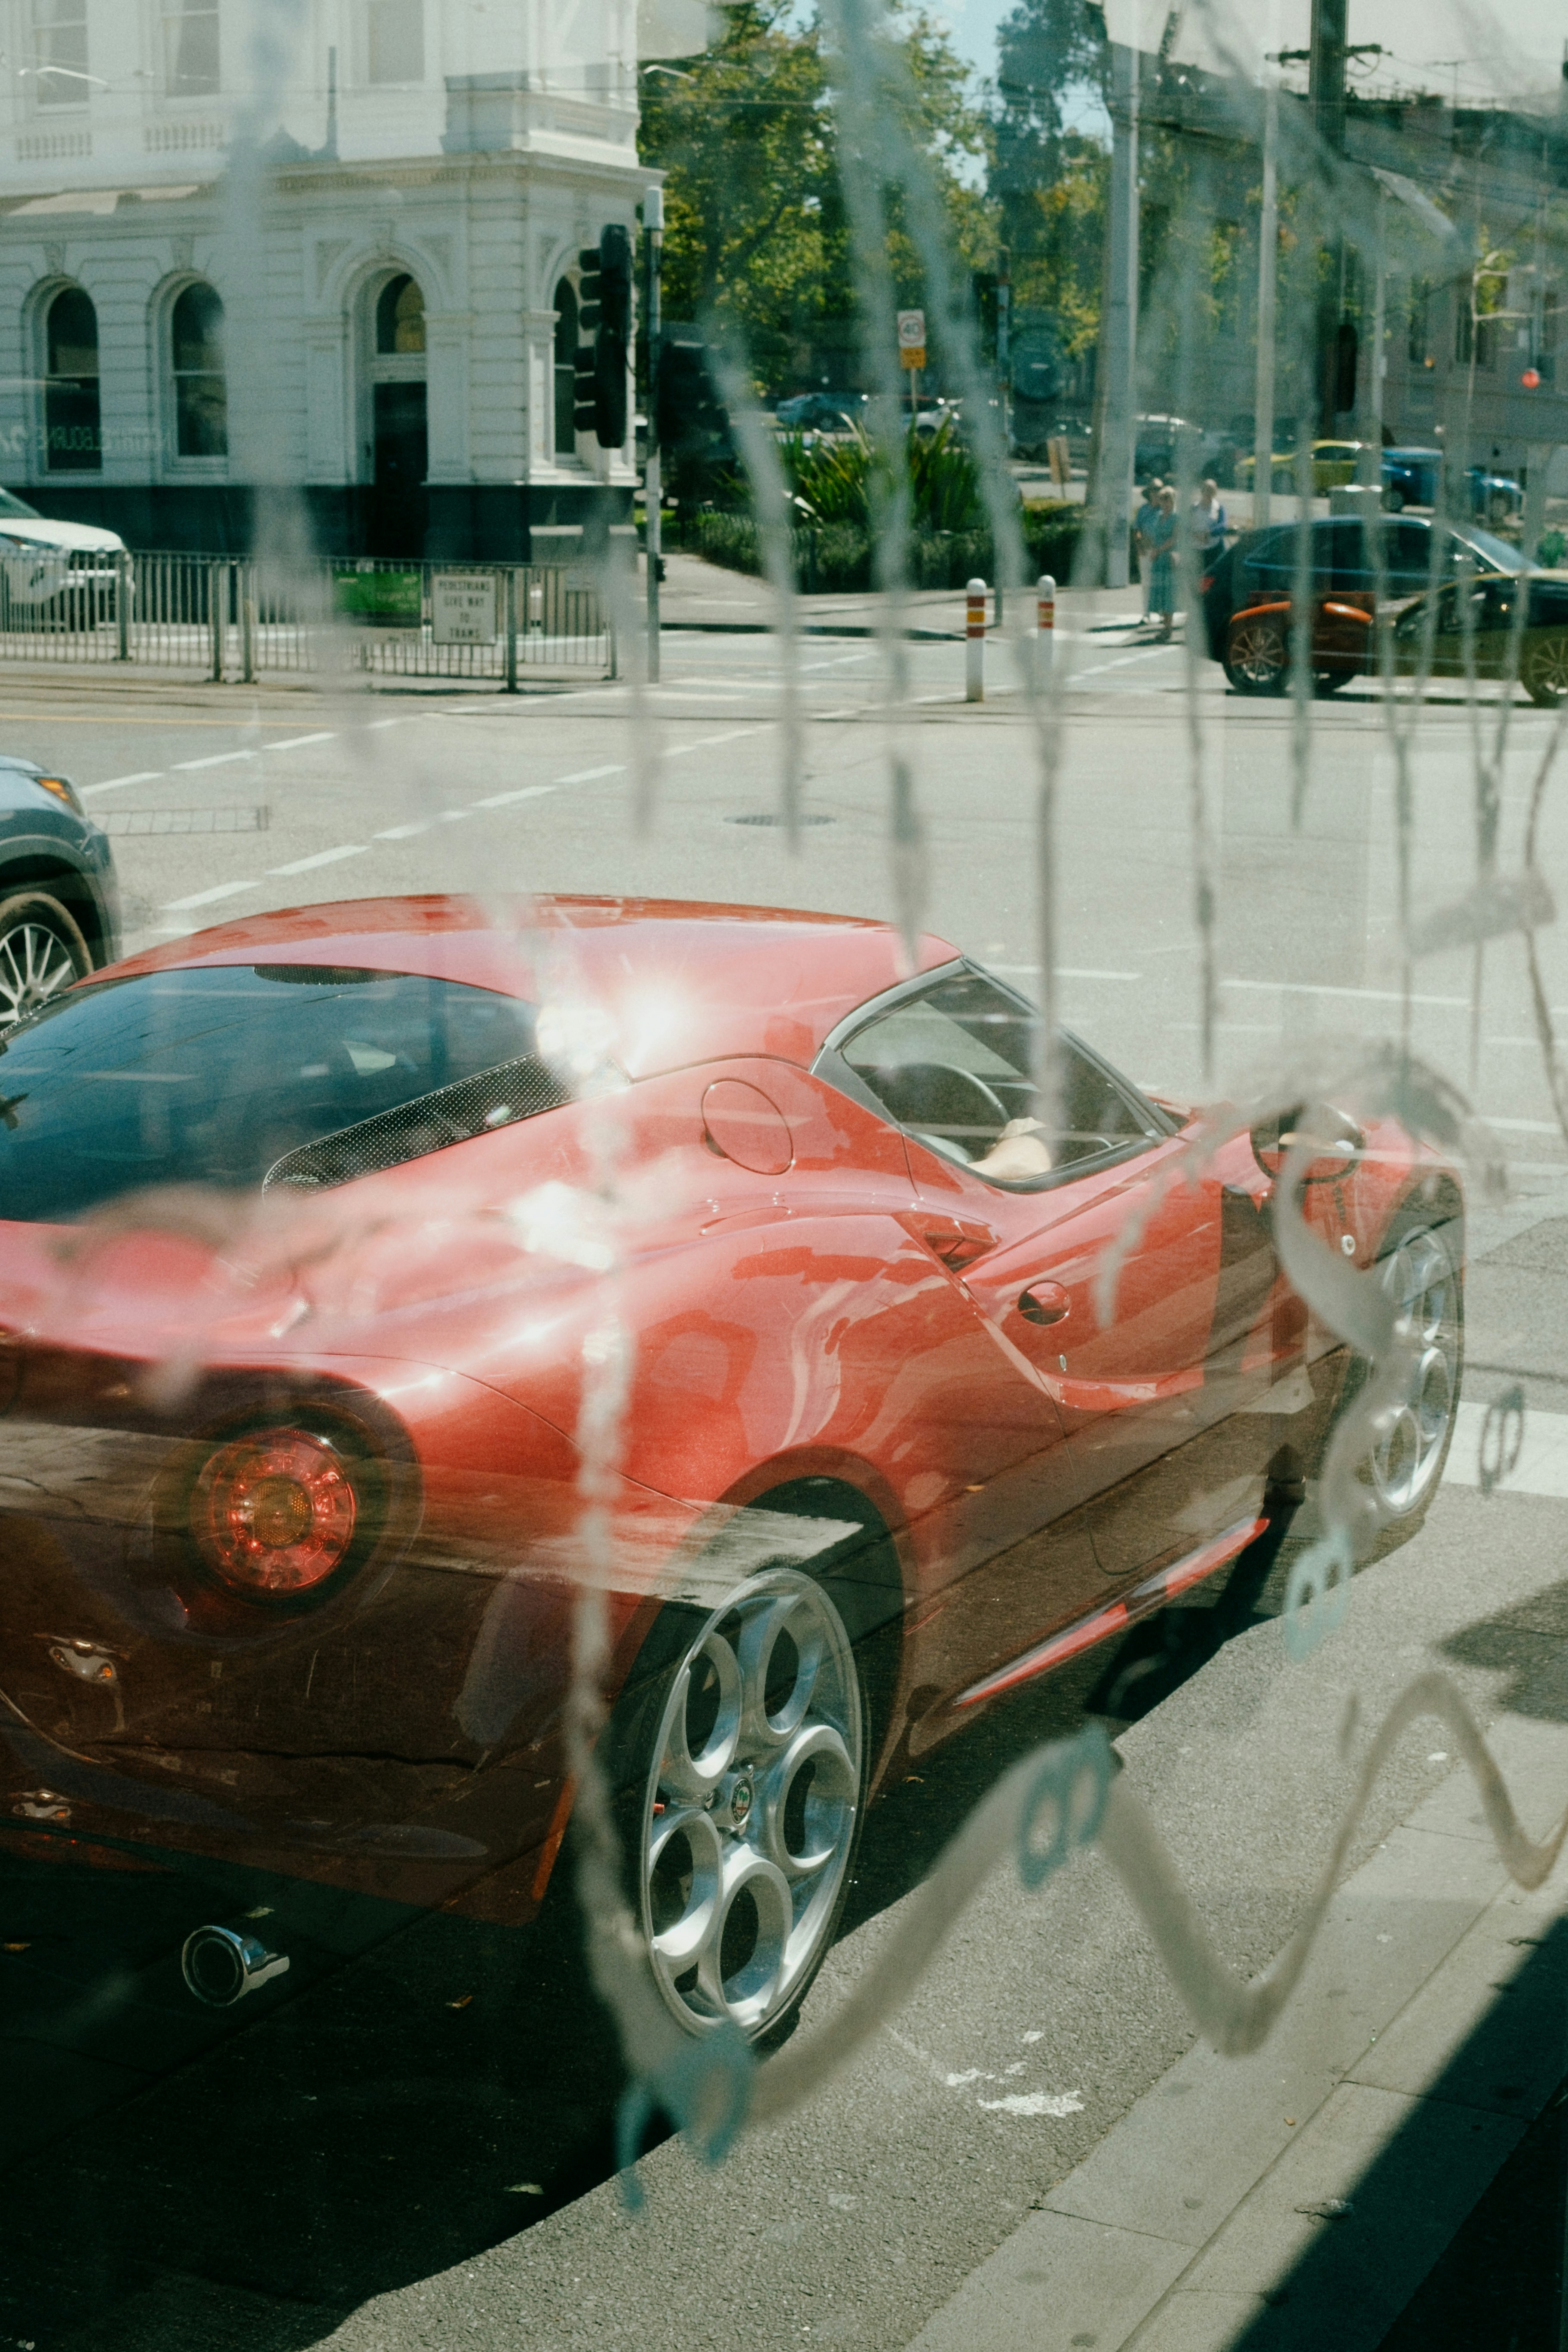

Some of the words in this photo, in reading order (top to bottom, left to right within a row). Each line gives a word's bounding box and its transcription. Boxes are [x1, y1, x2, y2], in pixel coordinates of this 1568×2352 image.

[438, 580, 490, 592] PEDESTRIANS
[444, 595, 463, 607] GIVE
[467, 596, 484, 607] WAY
[459, 612, 470, 623] TO
[450, 627, 480, 639] TRAMS
